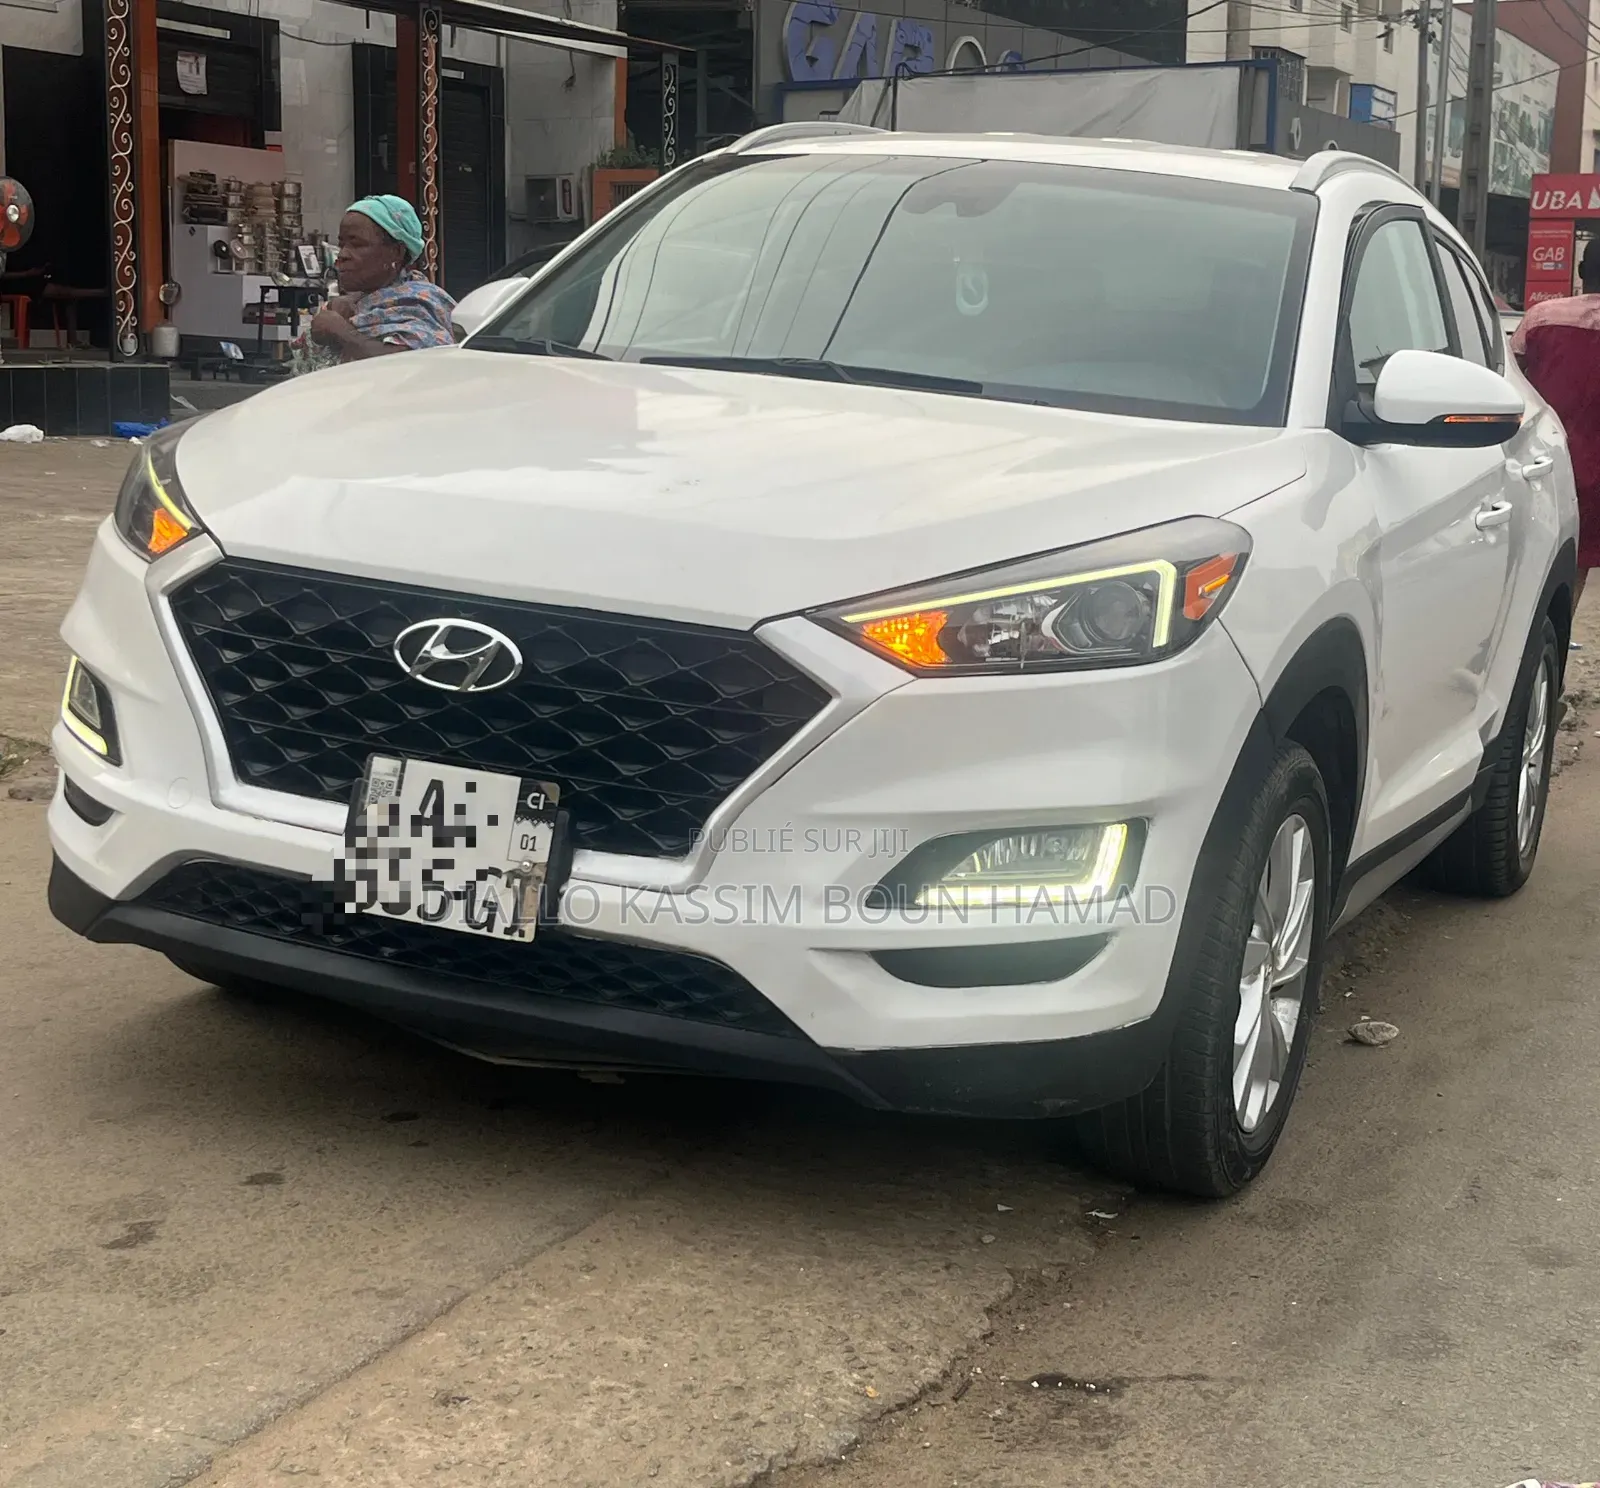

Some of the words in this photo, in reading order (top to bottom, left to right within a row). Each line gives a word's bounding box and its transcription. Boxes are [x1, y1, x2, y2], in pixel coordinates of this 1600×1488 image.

[1532, 190, 1583, 209] UBA
[1532, 246, 1565, 261] GAB
[527, 792, 546, 811] CI
[520, 834, 537, 852] 01
